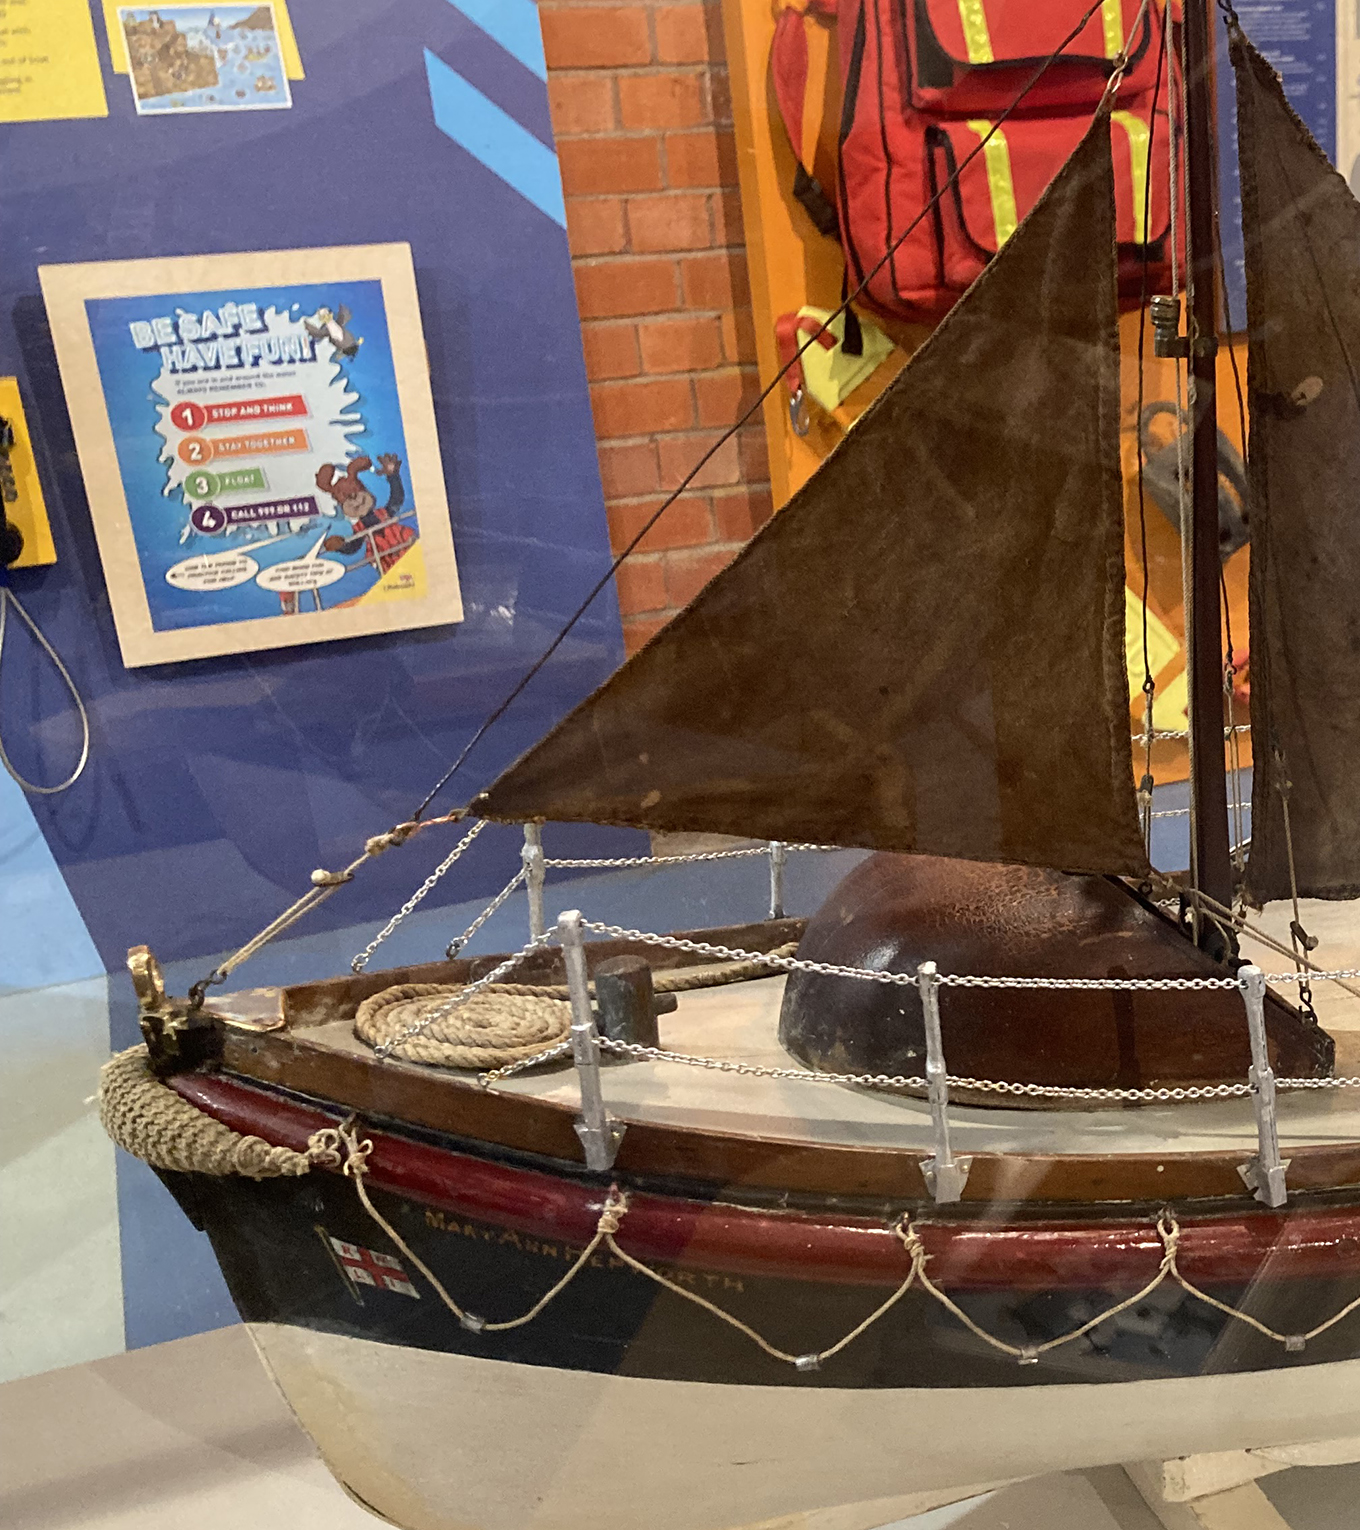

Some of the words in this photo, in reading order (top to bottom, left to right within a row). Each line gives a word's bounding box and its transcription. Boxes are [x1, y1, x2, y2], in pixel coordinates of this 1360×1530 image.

[130, 317, 178, 350] BE
[178, 302, 263, 342] SAFE
[160, 338, 240, 371] HAVE
[243, 335, 314, 367] FUN!
[181, 408, 194, 426] 1
[211, 408, 237, 419] STOP
[188, 443, 203, 461] 2
[195, 477, 209, 495] 3
[202, 510, 216, 529] 4
[231, 508, 256, 520] CALL
